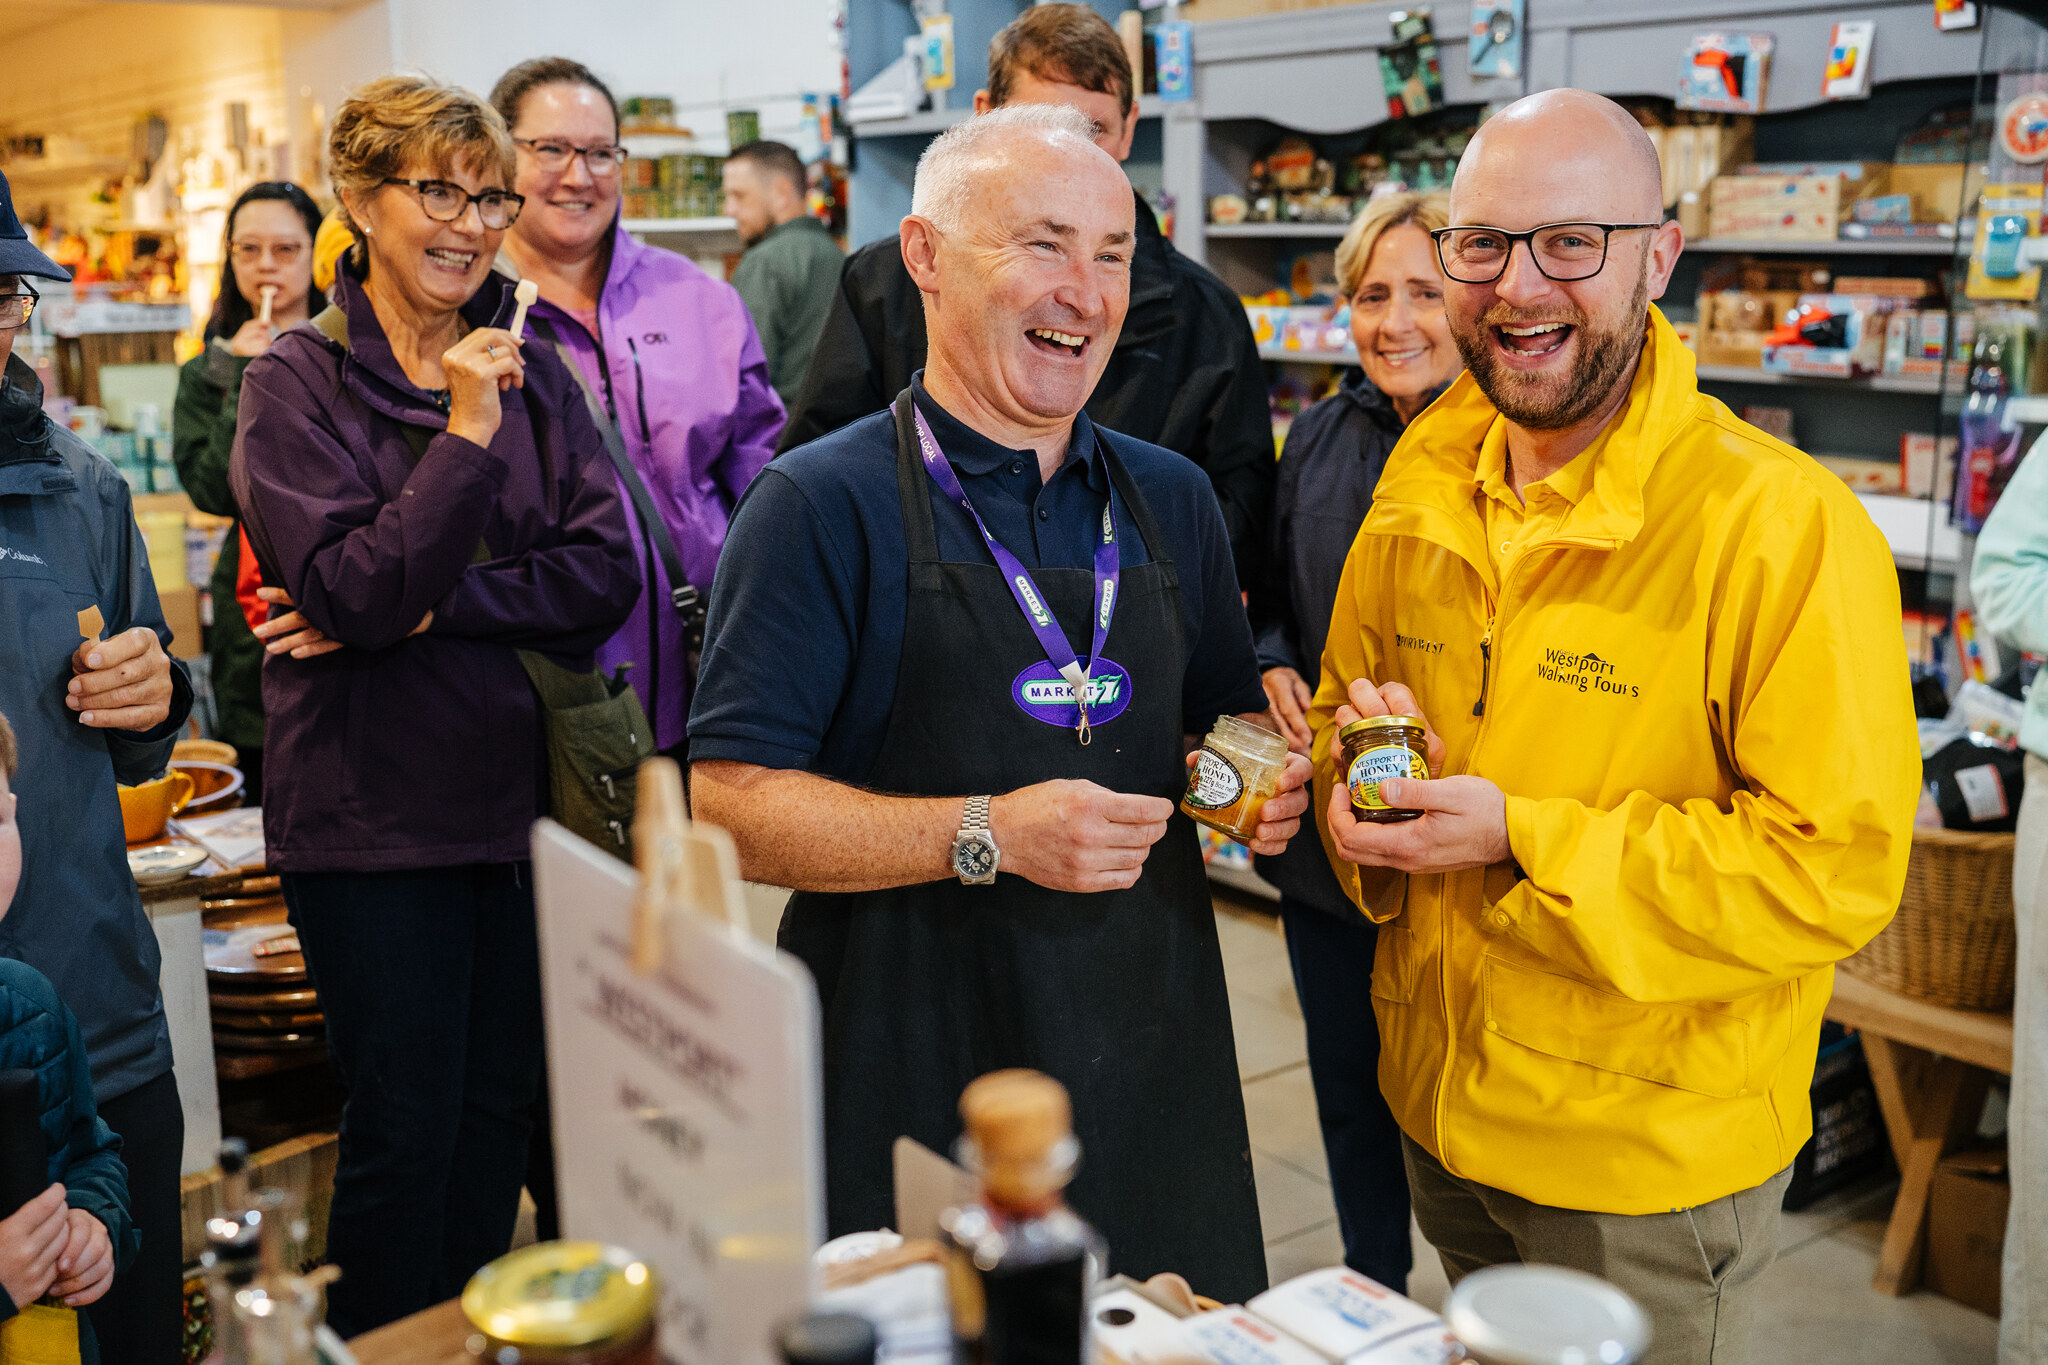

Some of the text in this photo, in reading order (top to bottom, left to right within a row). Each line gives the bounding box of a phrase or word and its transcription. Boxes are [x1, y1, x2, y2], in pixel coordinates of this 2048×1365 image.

[919, 435, 938, 464] LOCAL
[1018, 579, 1041, 610] MARKET
[1101, 581, 1112, 614] MARKET
[1400, 635, 1446, 655] PORTWEST
[1546, 647, 1616, 676] Westport
[1537, 663, 1640, 698] Walking Tours
[1030, 686, 1095, 697] MARKT
[1355, 754, 1398, 770] WESTPORT
[1360, 762, 1400, 779] HONEY
[1202, 764, 1235, 785] HONEY
[1203, 775, 1215, 788] 227g
[1215, 780, 1225, 791] 8oz
[1362, 776, 1377, 787] 227g
